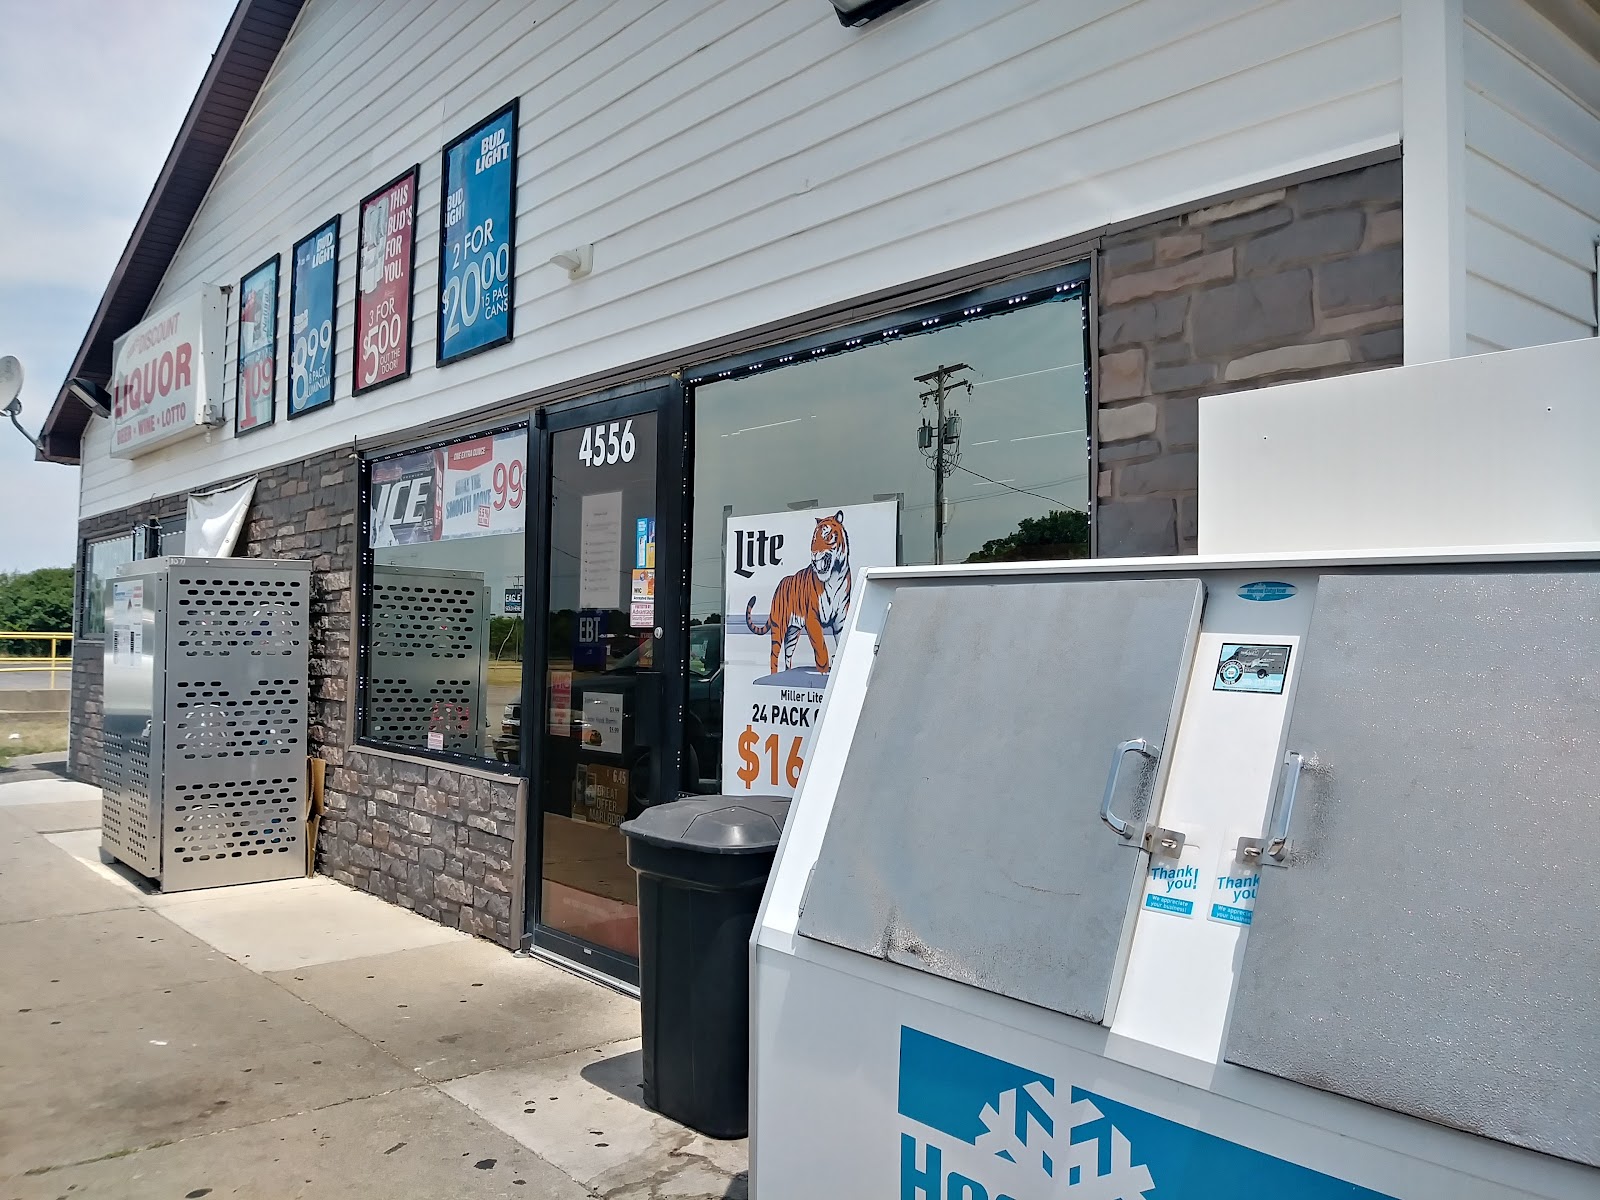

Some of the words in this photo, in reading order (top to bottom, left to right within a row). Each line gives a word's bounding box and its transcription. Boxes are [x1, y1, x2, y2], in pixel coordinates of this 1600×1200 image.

[481, 128, 505, 155] BUD
[475, 142, 509, 175] LIGHT
[390, 184, 408, 212] THIS
[447, 187, 464, 211] BUD
[387, 205, 413, 236] BUD'S
[445, 200, 465, 227] LIGHT
[317, 232, 333, 253] BUD
[385, 235, 402, 260] FOR
[452, 243, 460, 270] 2
[464, 218, 494, 260] FOR
[312, 244, 335, 268] LIGHT
[384, 259, 404, 284] YOU.
[492, 284, 508, 302] PAC
[369, 310, 374, 327] 3
[376, 297, 395, 322] FOR
[485, 298, 508, 319] CANS
[380, 352, 390, 366] OUT
[391, 348, 401, 360] THE
[114, 342, 192, 420] LIQUOR
[312, 363, 327, 382] PACK
[162, 402, 186, 427] LOTTO
[579, 420, 636, 467] 4556
[375, 476, 432, 528] ICE
[446, 494, 472, 519] SMOOTH
[734, 530, 784, 578] Lite
[579, 617, 600, 643] EBT
[780, 689, 805, 702] Miller
[807, 691, 824, 704] Lite
[752, 703, 767, 723] 24
[771, 705, 810, 728] PACK
[737, 724, 804, 789] $16
[613, 769, 626, 785] 6.45
[596, 798, 617, 812] OFFER
[597, 785, 618, 800] GREAT
[1151, 865, 1193, 880] Thank
[1166, 868, 1199, 893] you!
[1217, 874, 1260, 889] Thank
[1161, 897, 1189, 907] appreciate
